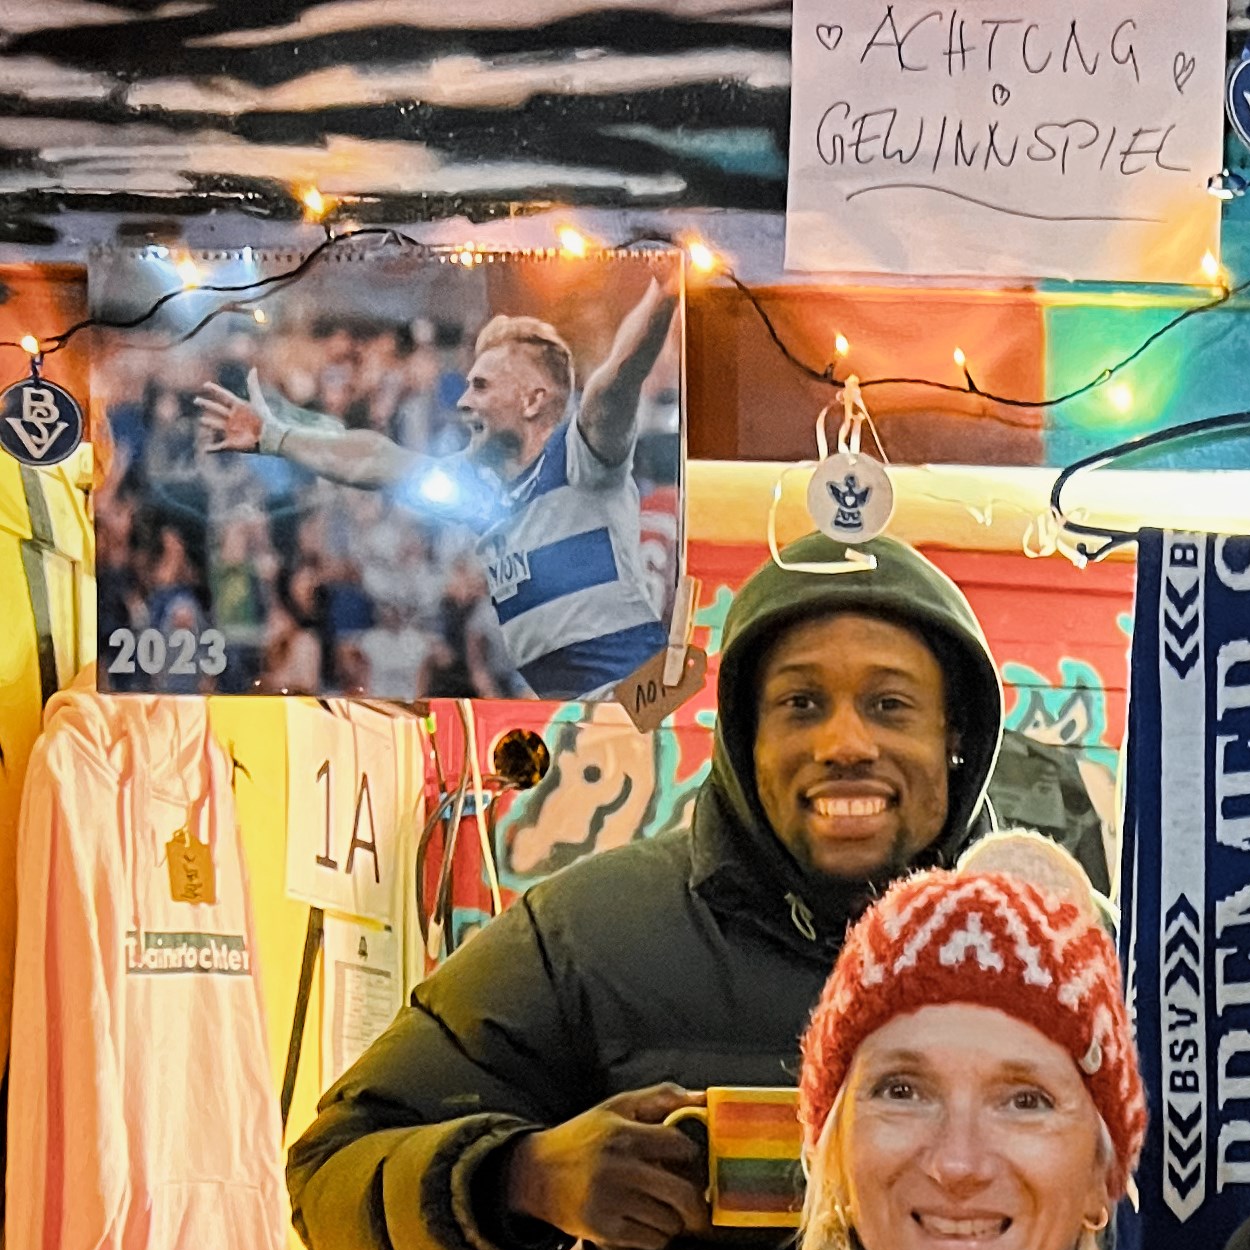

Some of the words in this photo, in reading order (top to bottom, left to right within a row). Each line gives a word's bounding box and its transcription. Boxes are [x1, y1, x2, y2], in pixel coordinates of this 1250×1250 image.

[860, 4, 1141, 84] ACHTUNG
[815, 101, 1193, 176] GEWINNSPIEL
[108, 628, 228, 676] 2023
[315, 758, 380, 884] 1A
[1168, 1004, 1200, 1094] BSV
